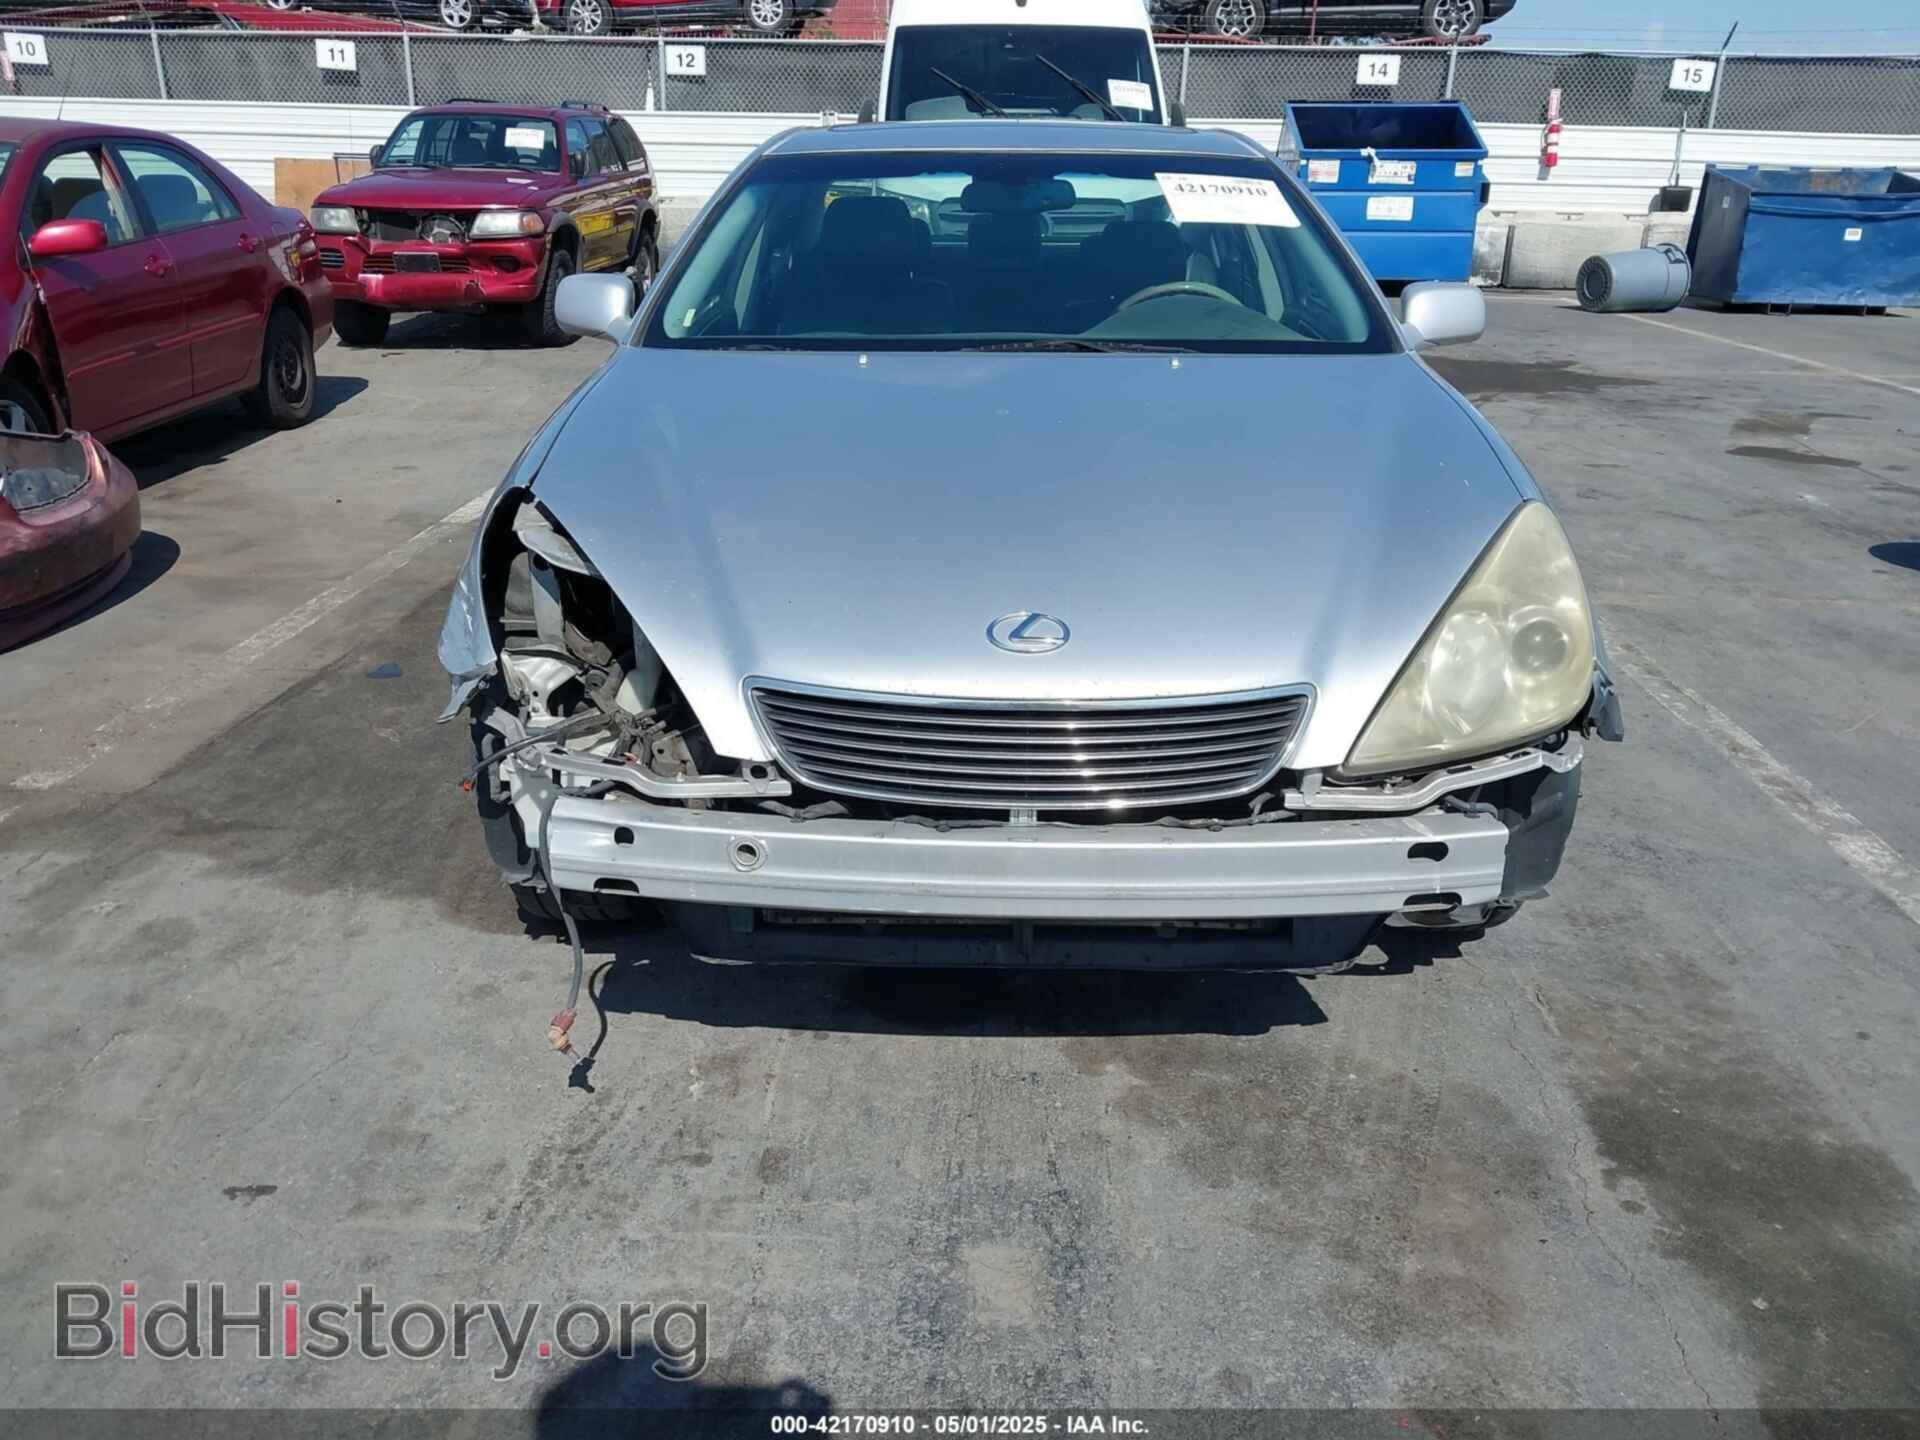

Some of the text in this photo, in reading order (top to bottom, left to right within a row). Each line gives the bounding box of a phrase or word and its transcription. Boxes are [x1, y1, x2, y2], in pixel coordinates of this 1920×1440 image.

[16, 40, 36, 57] 10
[328, 47, 346, 63] 11
[676, 53, 696, 68] 12
[1369, 62, 1388, 77] 14
[1682, 68, 1703, 83] 15
[1173, 182, 1268, 197] 42170910
